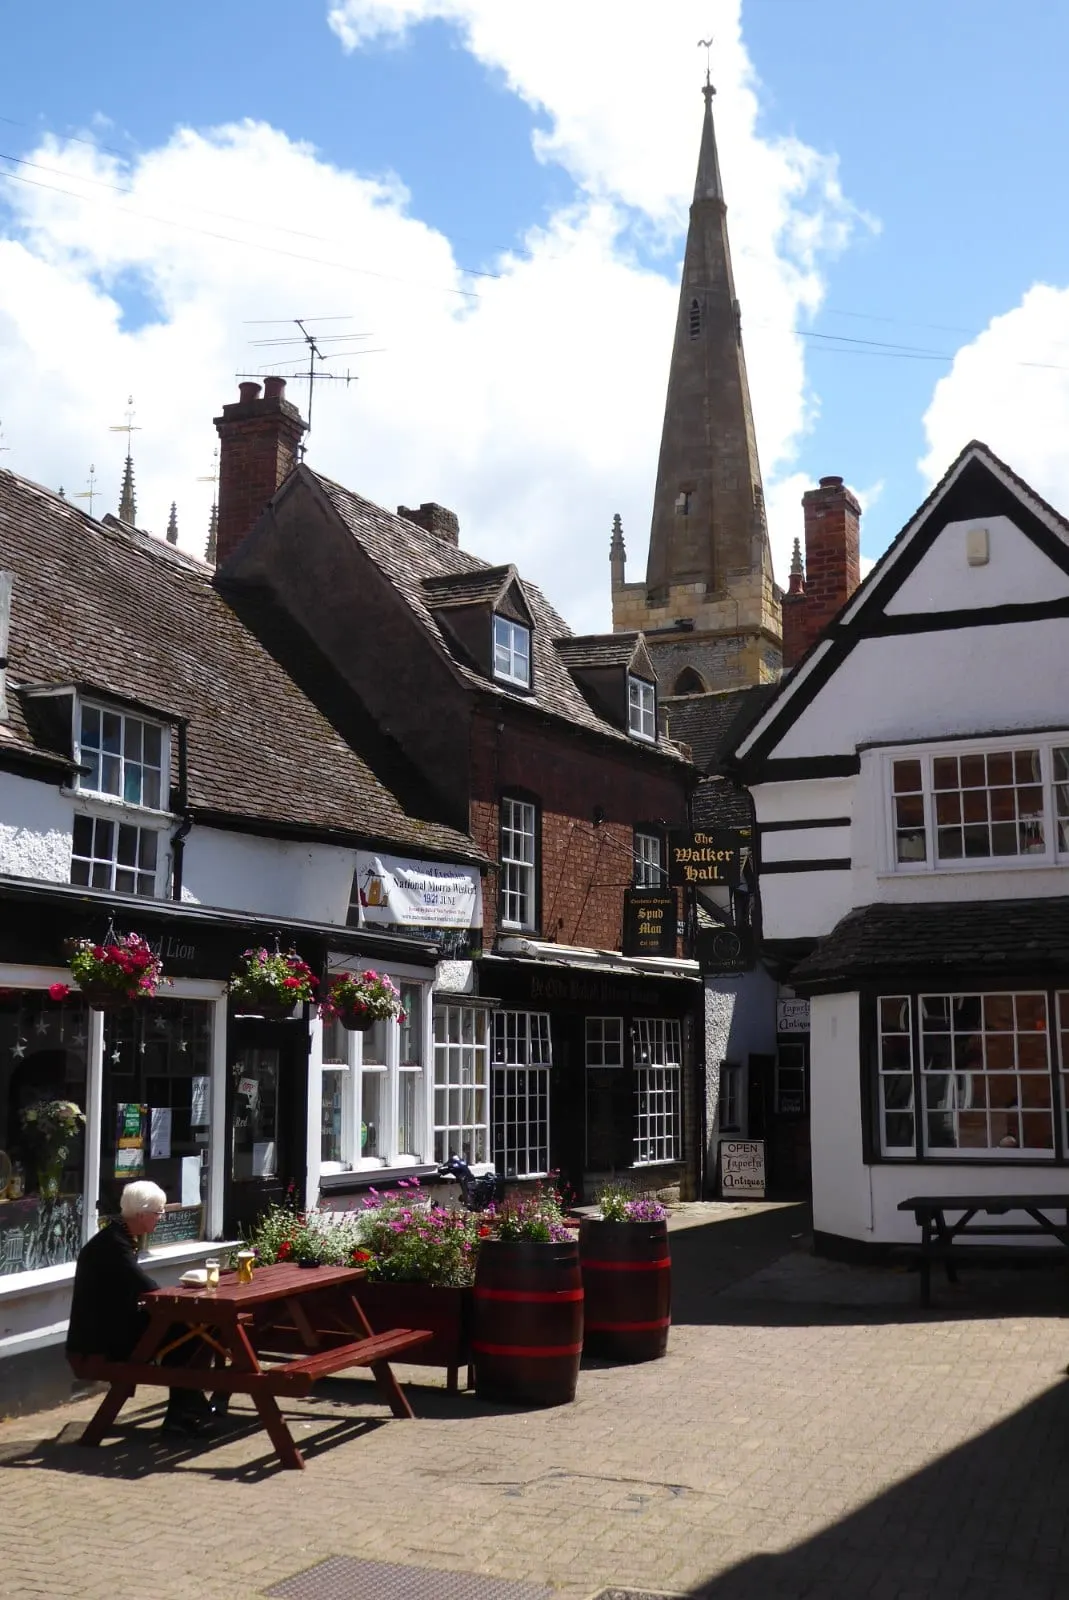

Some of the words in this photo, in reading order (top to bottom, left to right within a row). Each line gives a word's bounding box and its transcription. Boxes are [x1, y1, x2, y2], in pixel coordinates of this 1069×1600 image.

[693, 832, 713, 844] The
[673, 848, 735, 862] Walker
[683, 865, 724, 882] Hall.
[393, 878, 426, 893] National
[428, 880, 451, 893] Morris
[440, 896, 456, 905] JUNE
[637, 907, 664, 920] Spud
[638, 922, 662, 935] Man
[151, 935, 163, 955] ed
[166, 936, 196, 960] Lion
[727, 1143, 758, 1153] OPEN
[723, 1174, 765, 1188] Antiques
